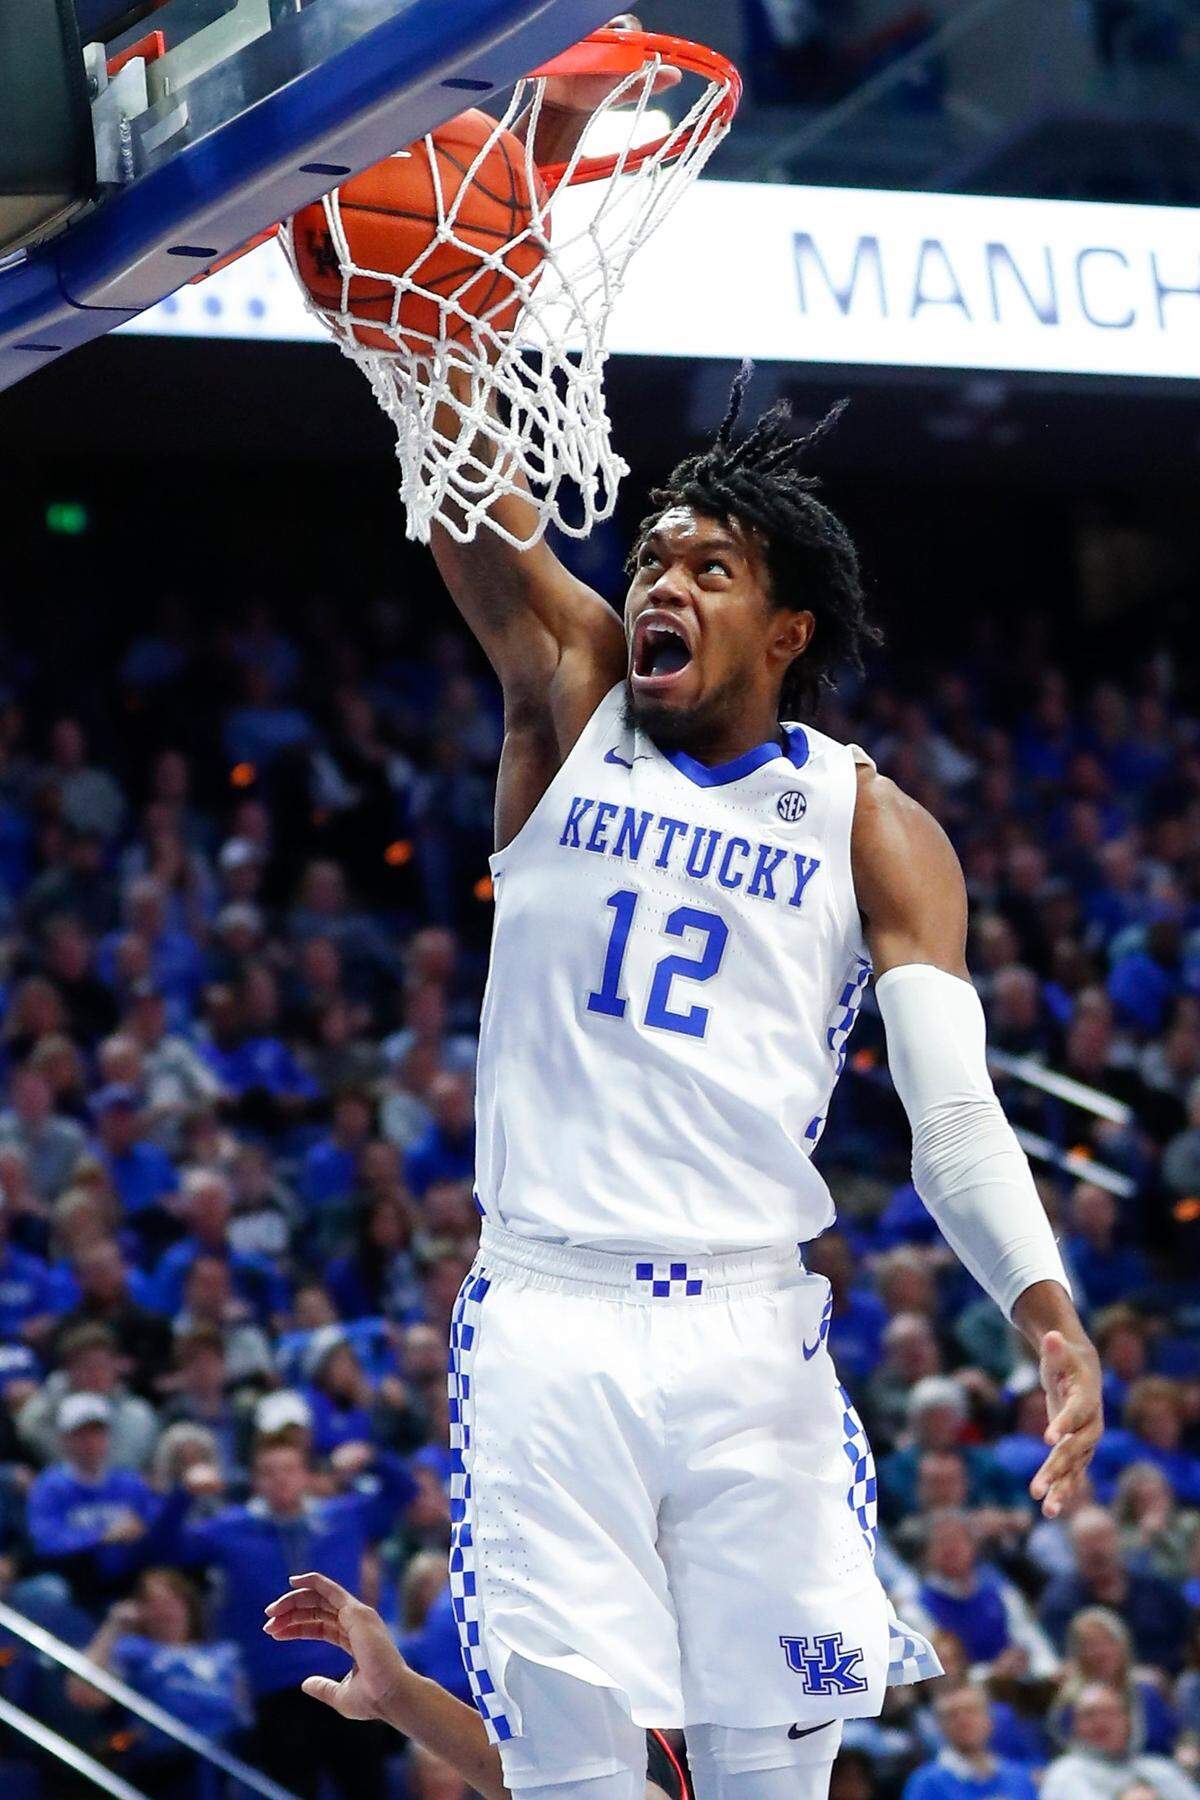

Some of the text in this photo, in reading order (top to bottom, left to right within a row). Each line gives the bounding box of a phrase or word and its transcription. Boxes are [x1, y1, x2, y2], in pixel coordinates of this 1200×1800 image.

[793, 231, 1200, 330] MANCH
[558, 796, 821, 908] KENTUCKY
[777, 791, 807, 822] SEC
[585, 888, 730, 1040] 12
[779, 1632, 868, 1695] UK
